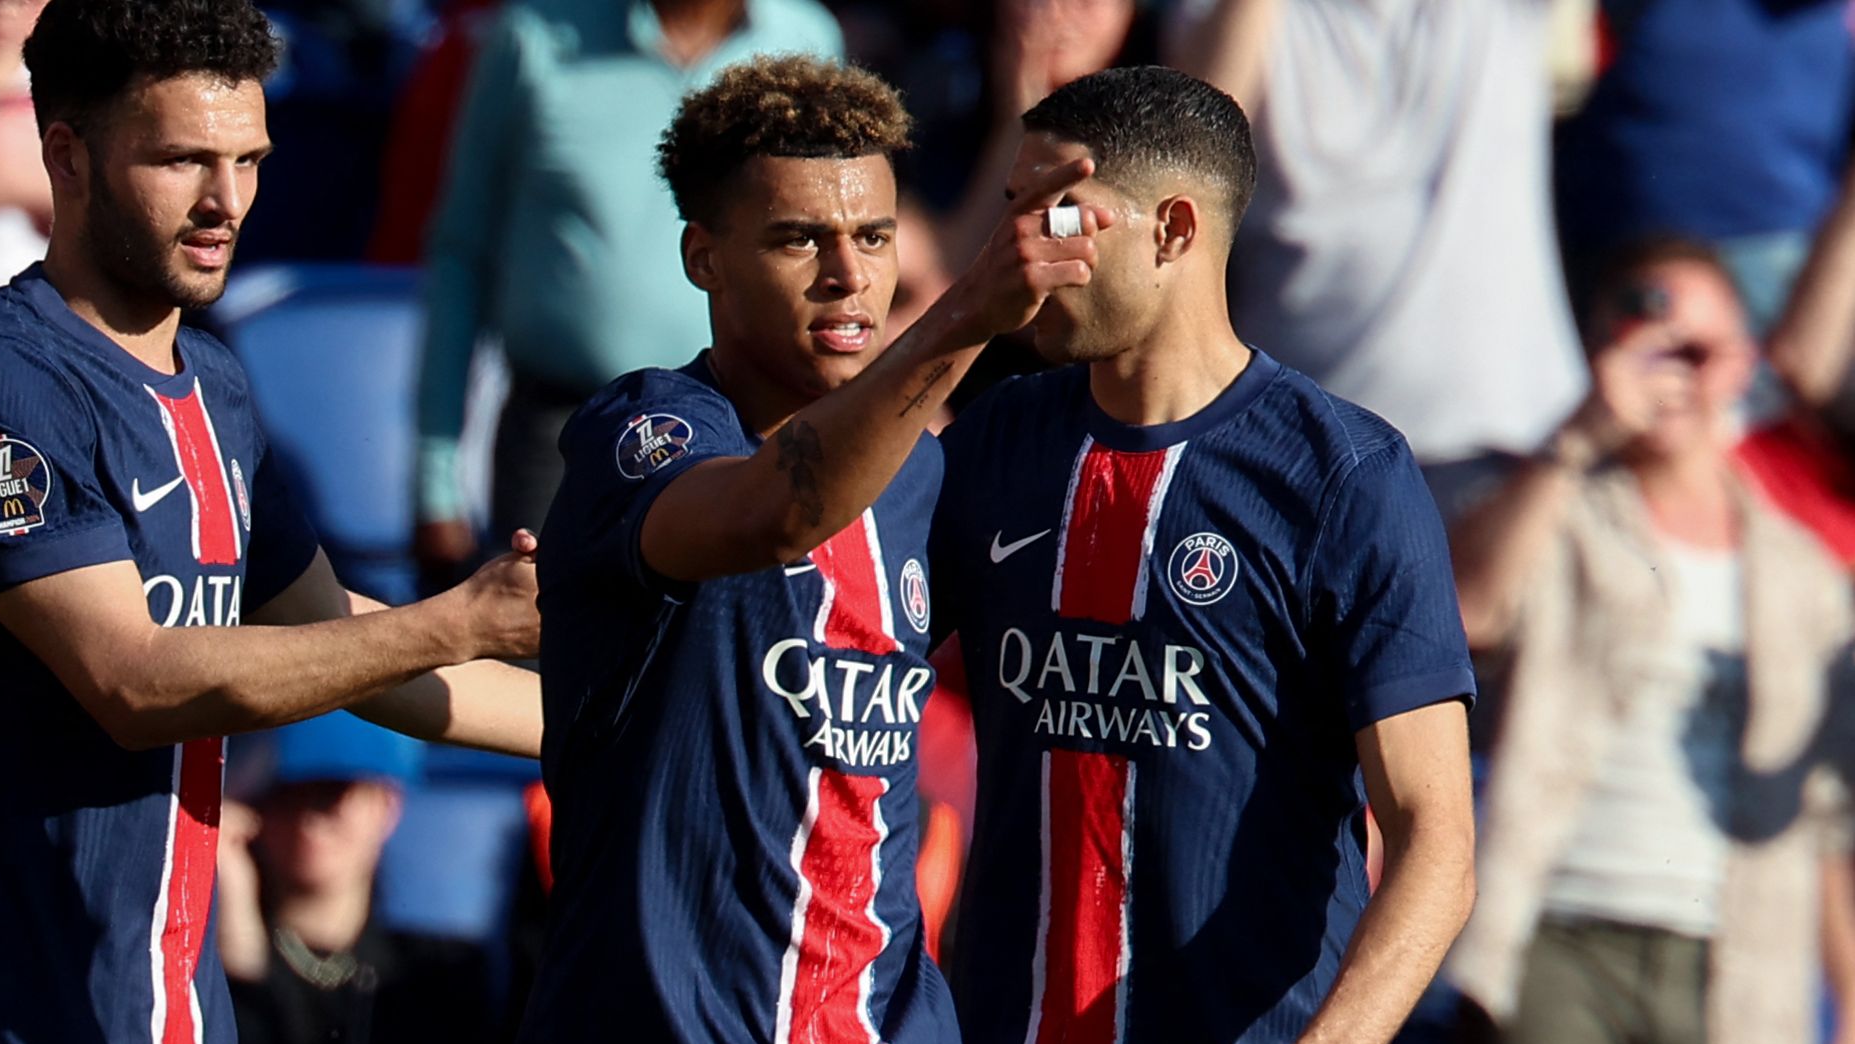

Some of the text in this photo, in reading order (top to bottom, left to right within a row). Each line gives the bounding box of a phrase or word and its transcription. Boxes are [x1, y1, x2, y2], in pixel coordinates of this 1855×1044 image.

[1184, 536, 1230, 558] PARIS
[762, 638, 931, 724] QATAR
[999, 627, 1211, 706] QATAR
[1034, 698, 1212, 750] AIRWAYS
